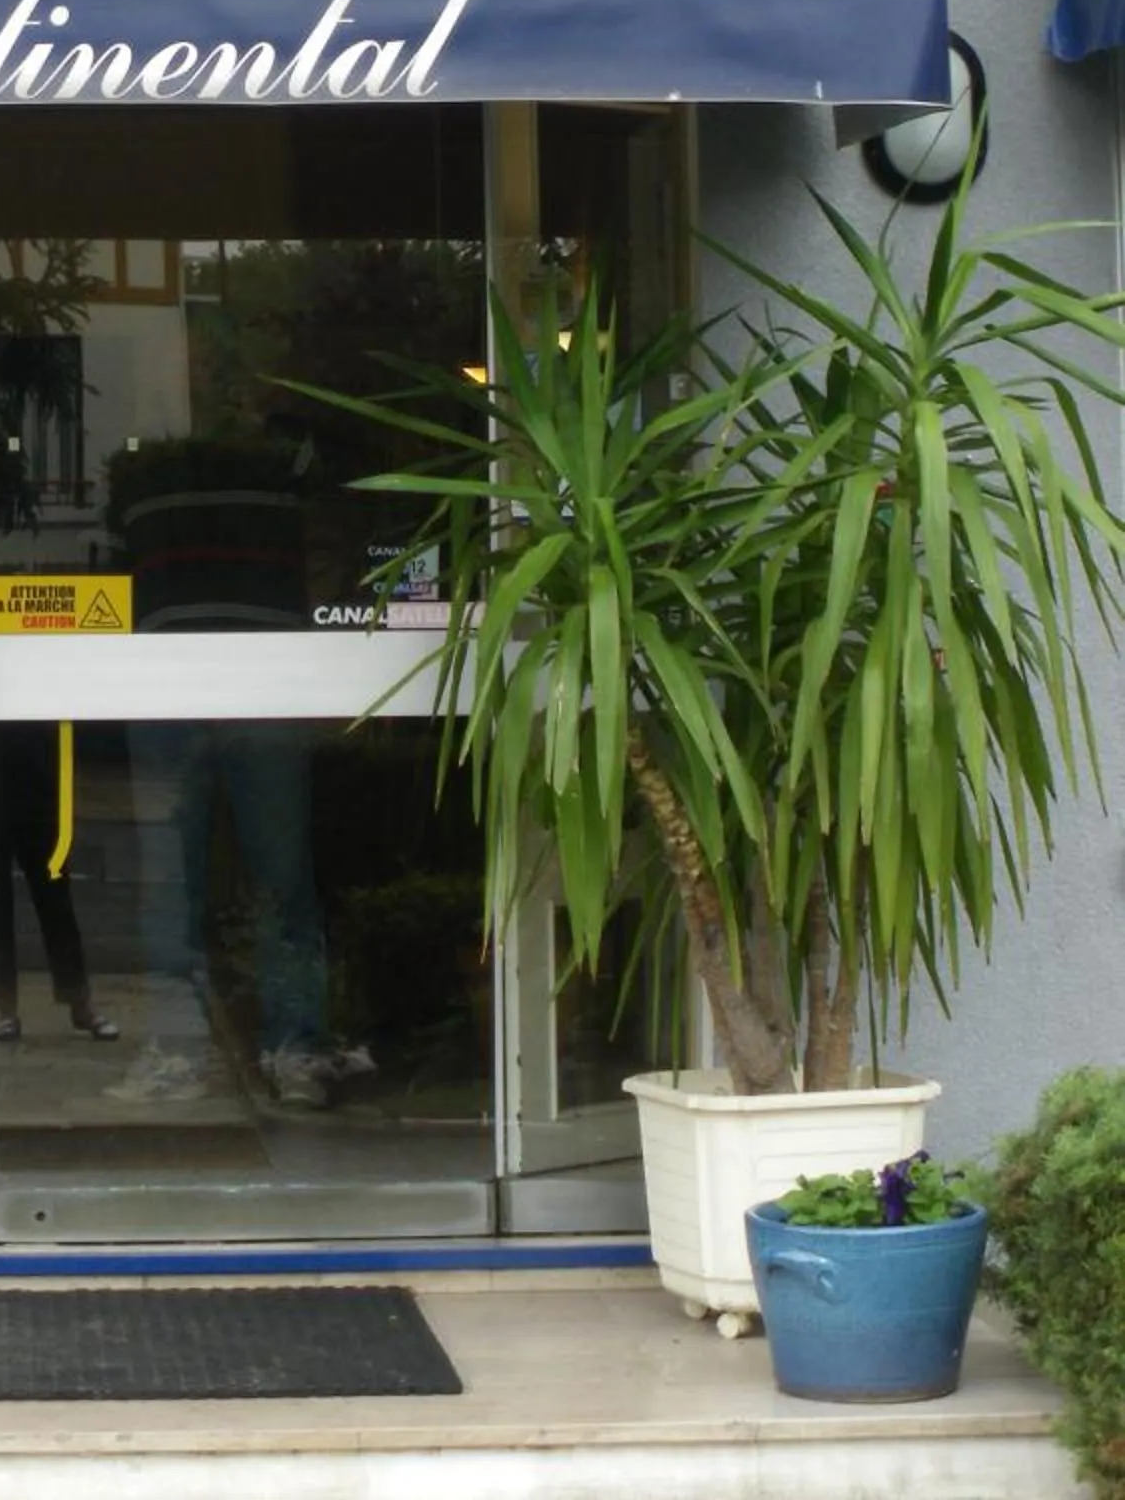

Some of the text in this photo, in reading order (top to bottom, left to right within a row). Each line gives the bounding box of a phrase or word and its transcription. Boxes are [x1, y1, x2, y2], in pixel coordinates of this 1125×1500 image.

[367, 546, 411, 557] CANA
[10, 585, 75, 599] ATTENTION
[8, 600, 22, 613] LA
[25, 600, 75, 613] MARCHE
[22, 615, 75, 629] CAUTION
